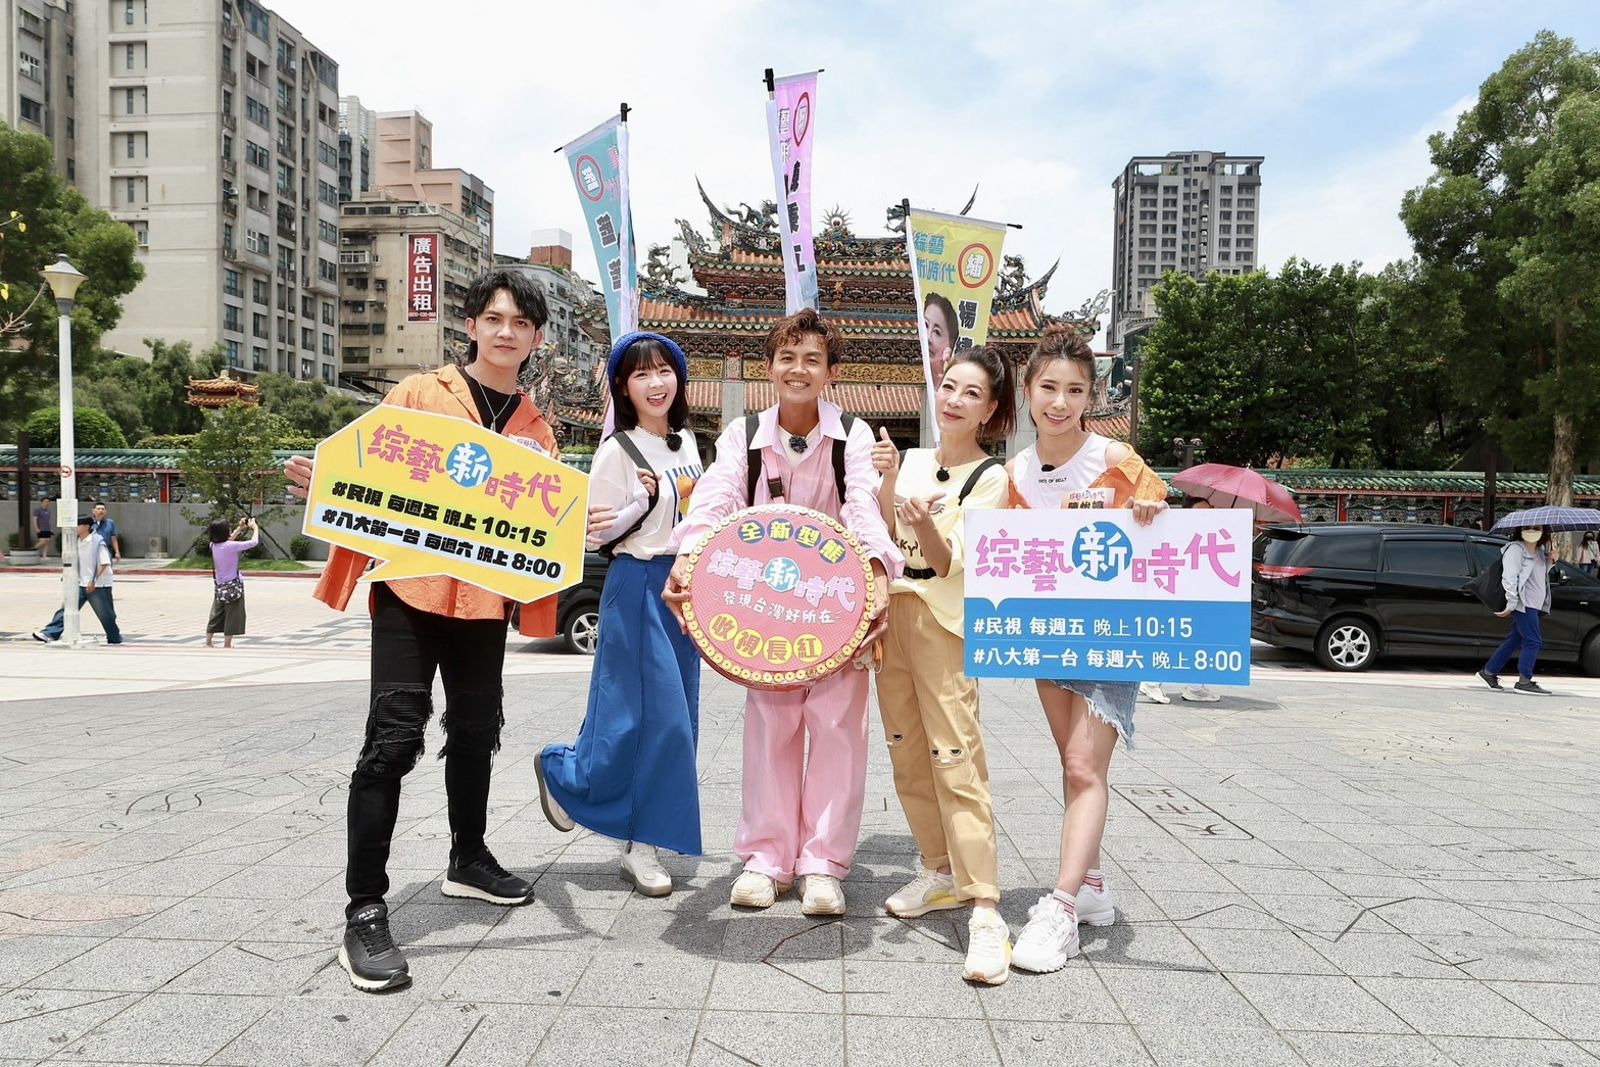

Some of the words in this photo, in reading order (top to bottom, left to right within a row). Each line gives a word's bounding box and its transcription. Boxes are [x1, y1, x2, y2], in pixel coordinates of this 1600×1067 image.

[413, 237, 432, 311] 廣告出租
[332, 481, 383, 506] #民視
[387, 494, 439, 522] 每週五
[443, 507, 477, 531] 晚上
[481, 515, 547, 547] 10:15
[322, 508, 421, 545] #八大第一台
[424, 533, 472, 559] 每週六
[477, 545, 508, 567] 晚上
[511, 552, 562, 579] 8:00
[722, 590, 836, 624] 發現台灣好所在
[973, 617, 1022, 636] #民視
[1029, 617, 1085, 637] 每週五
[1094, 618, 1131, 638] 晚上
[1134, 616, 1193, 639] 10:15
[711, 614, 817, 661] 收視長紅
[973, 647, 1078, 668] #八大第一台
[1086, 648, 1144, 669] 每週六
[1152, 650, 1191, 671] 晚上
[1193, 650, 1242, 673] 8:00
